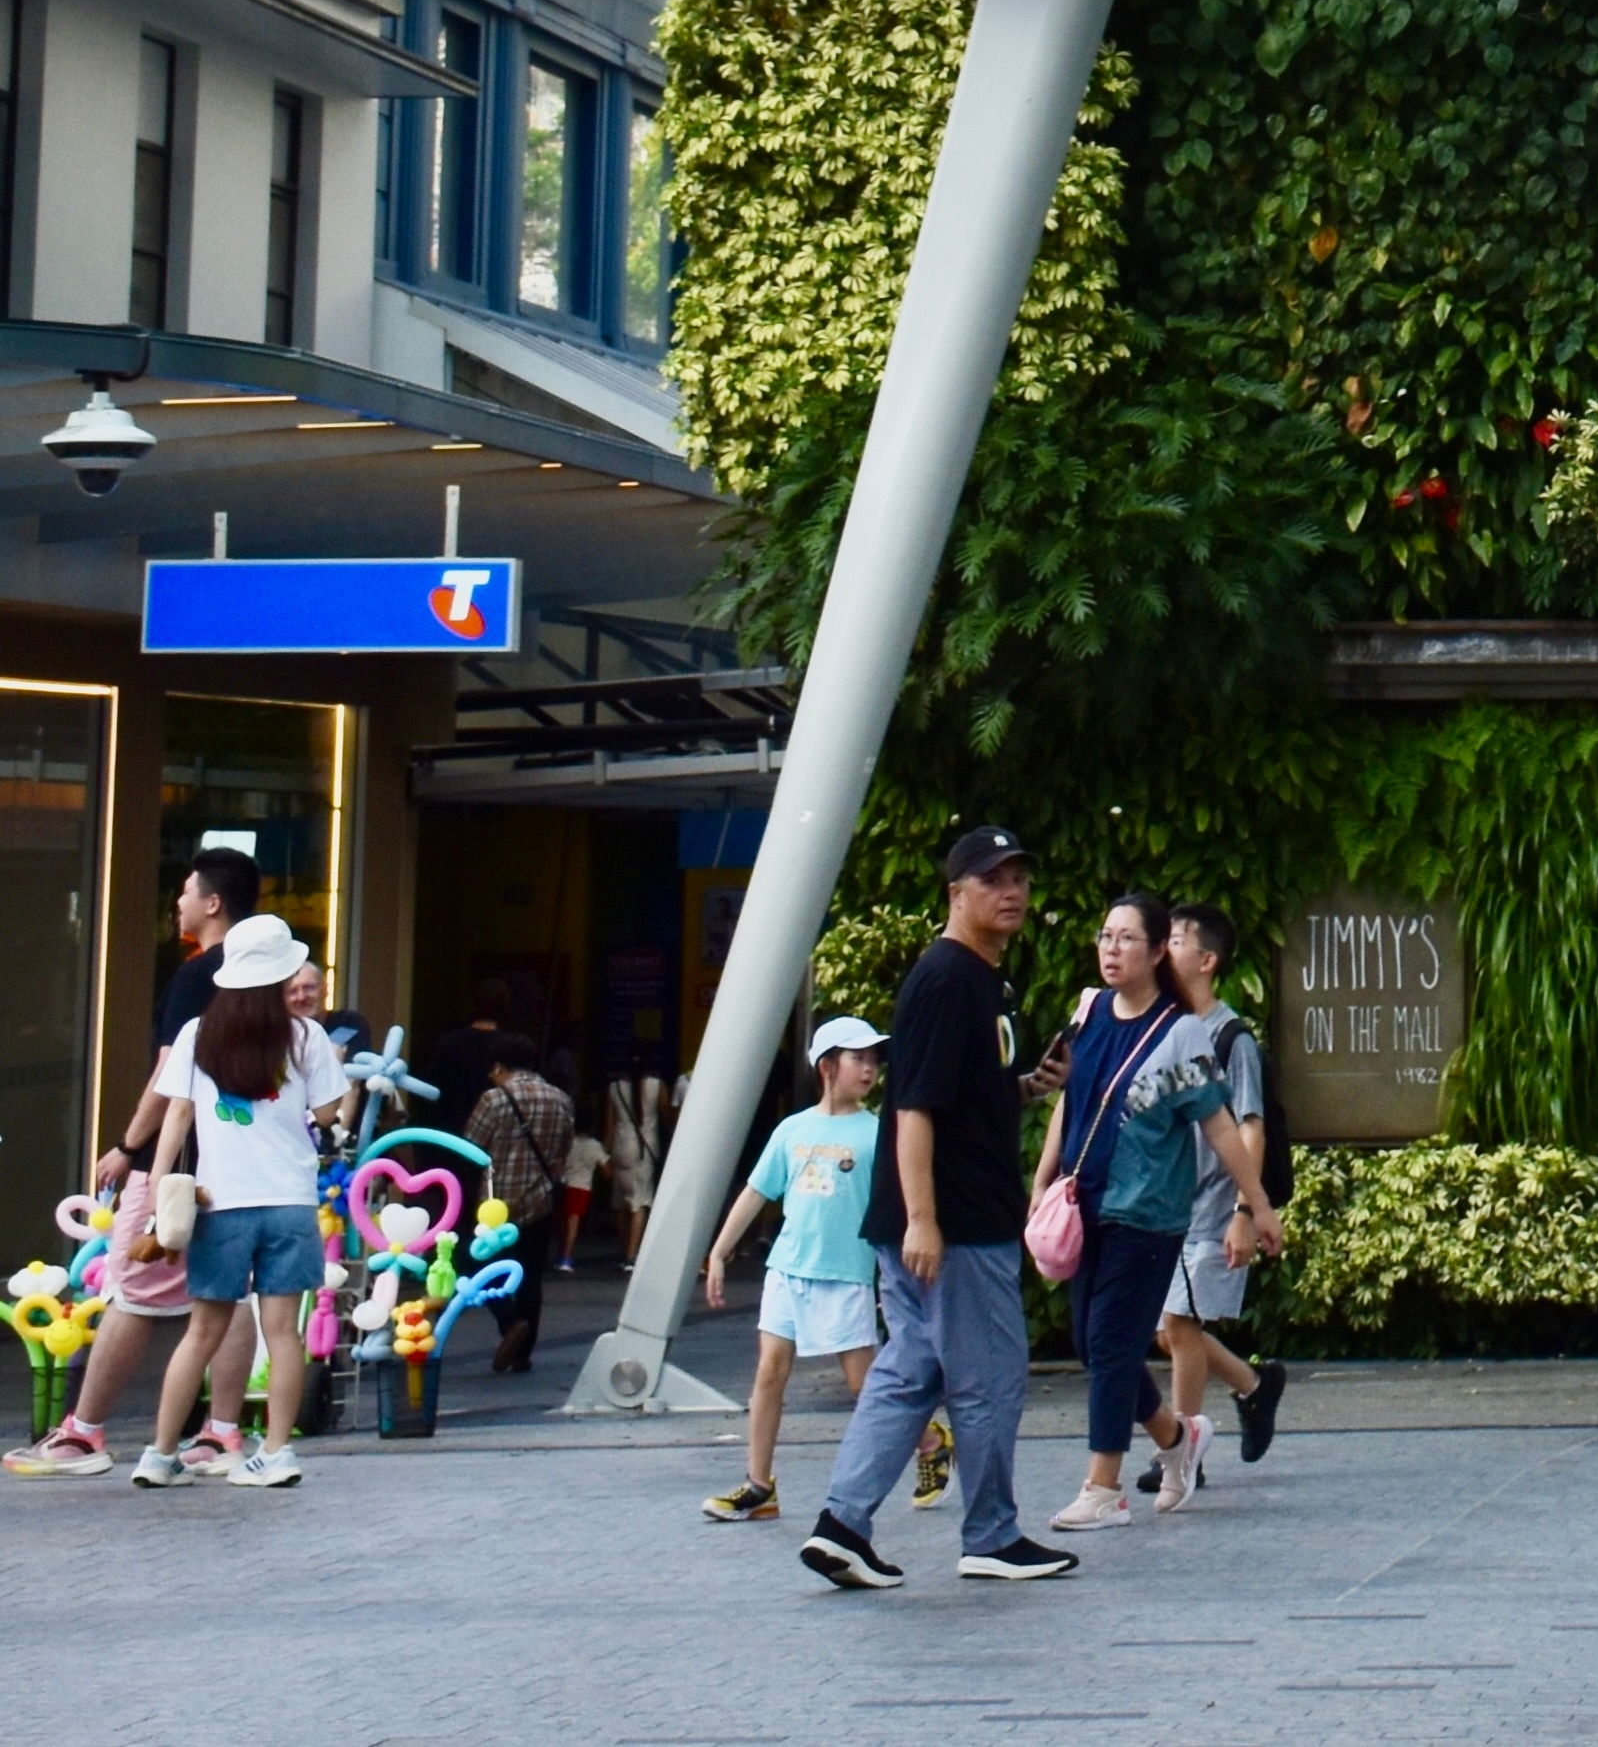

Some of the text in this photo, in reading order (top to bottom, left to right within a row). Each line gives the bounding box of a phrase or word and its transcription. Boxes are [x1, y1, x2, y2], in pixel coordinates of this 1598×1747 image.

[1302, 913, 1440, 991] JIMMY'S
[1304, 1005, 1442, 1053] ON THE MALL
[1395, 1067, 1439, 1084] 1982
